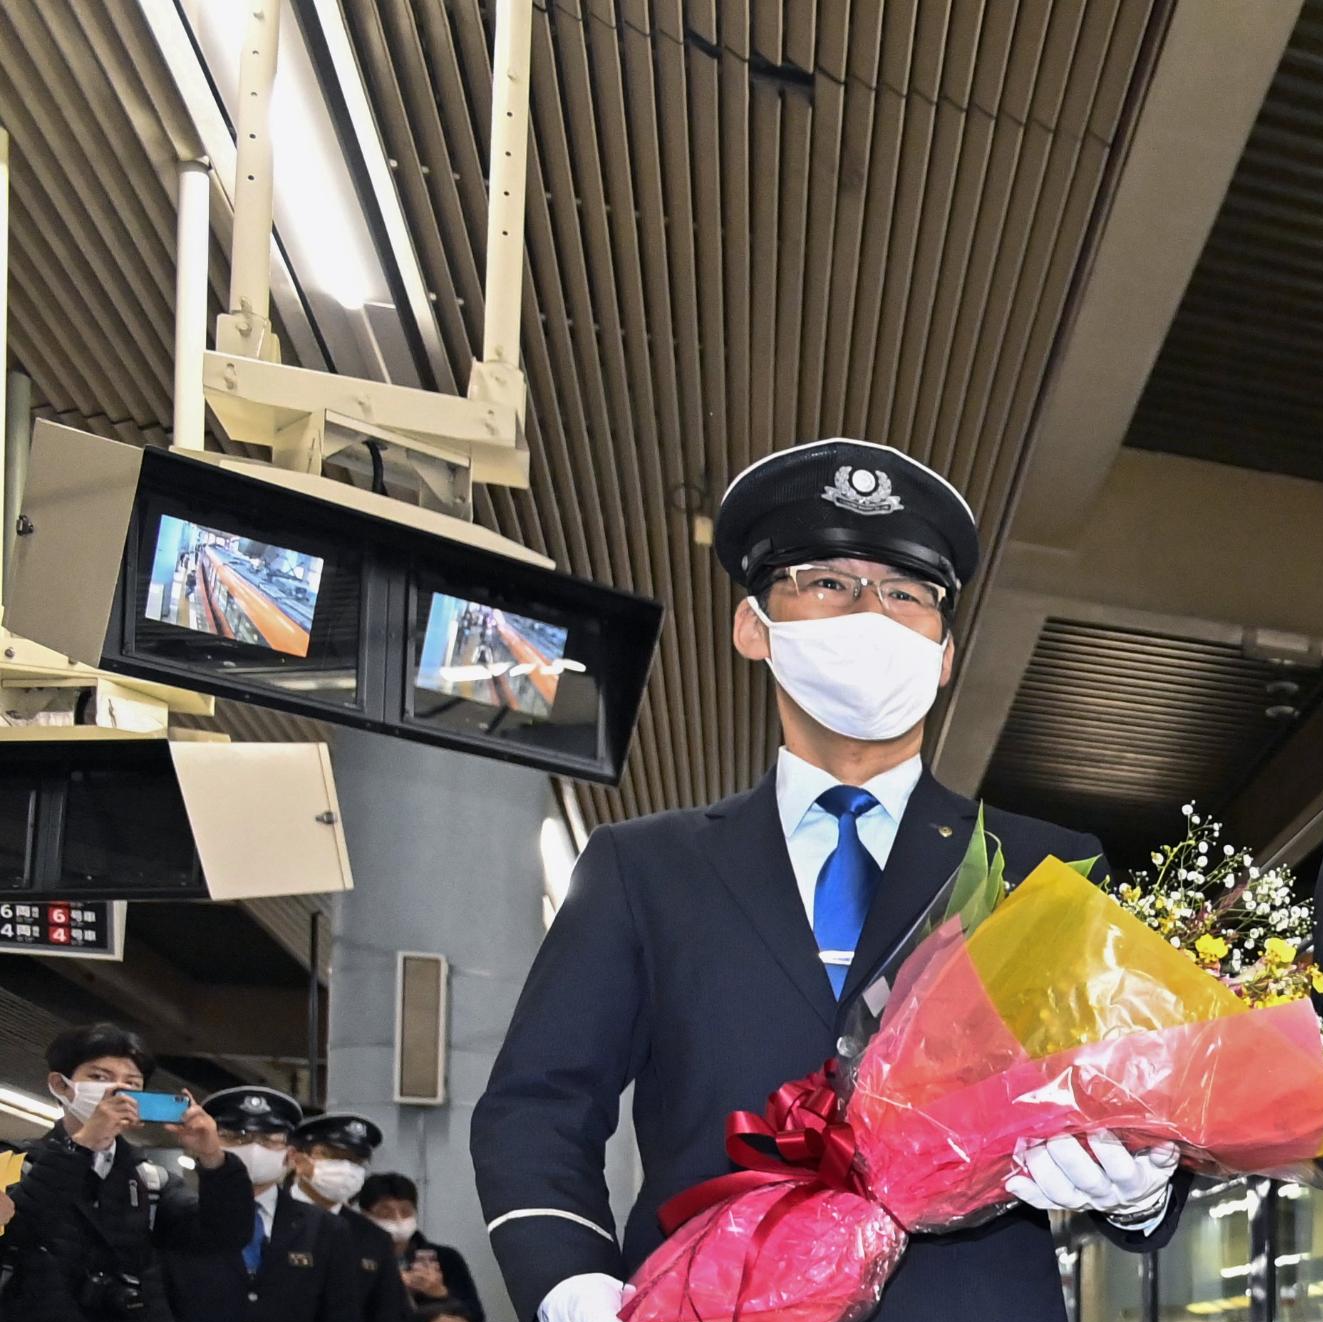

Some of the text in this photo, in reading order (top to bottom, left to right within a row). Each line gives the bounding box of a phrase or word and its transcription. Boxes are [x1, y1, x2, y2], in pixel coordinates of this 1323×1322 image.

[0, 904, 13, 918] 6
[52, 909, 66, 923] 6
[0, 923, 14, 938] 4
[53, 928, 67, 942] 4
